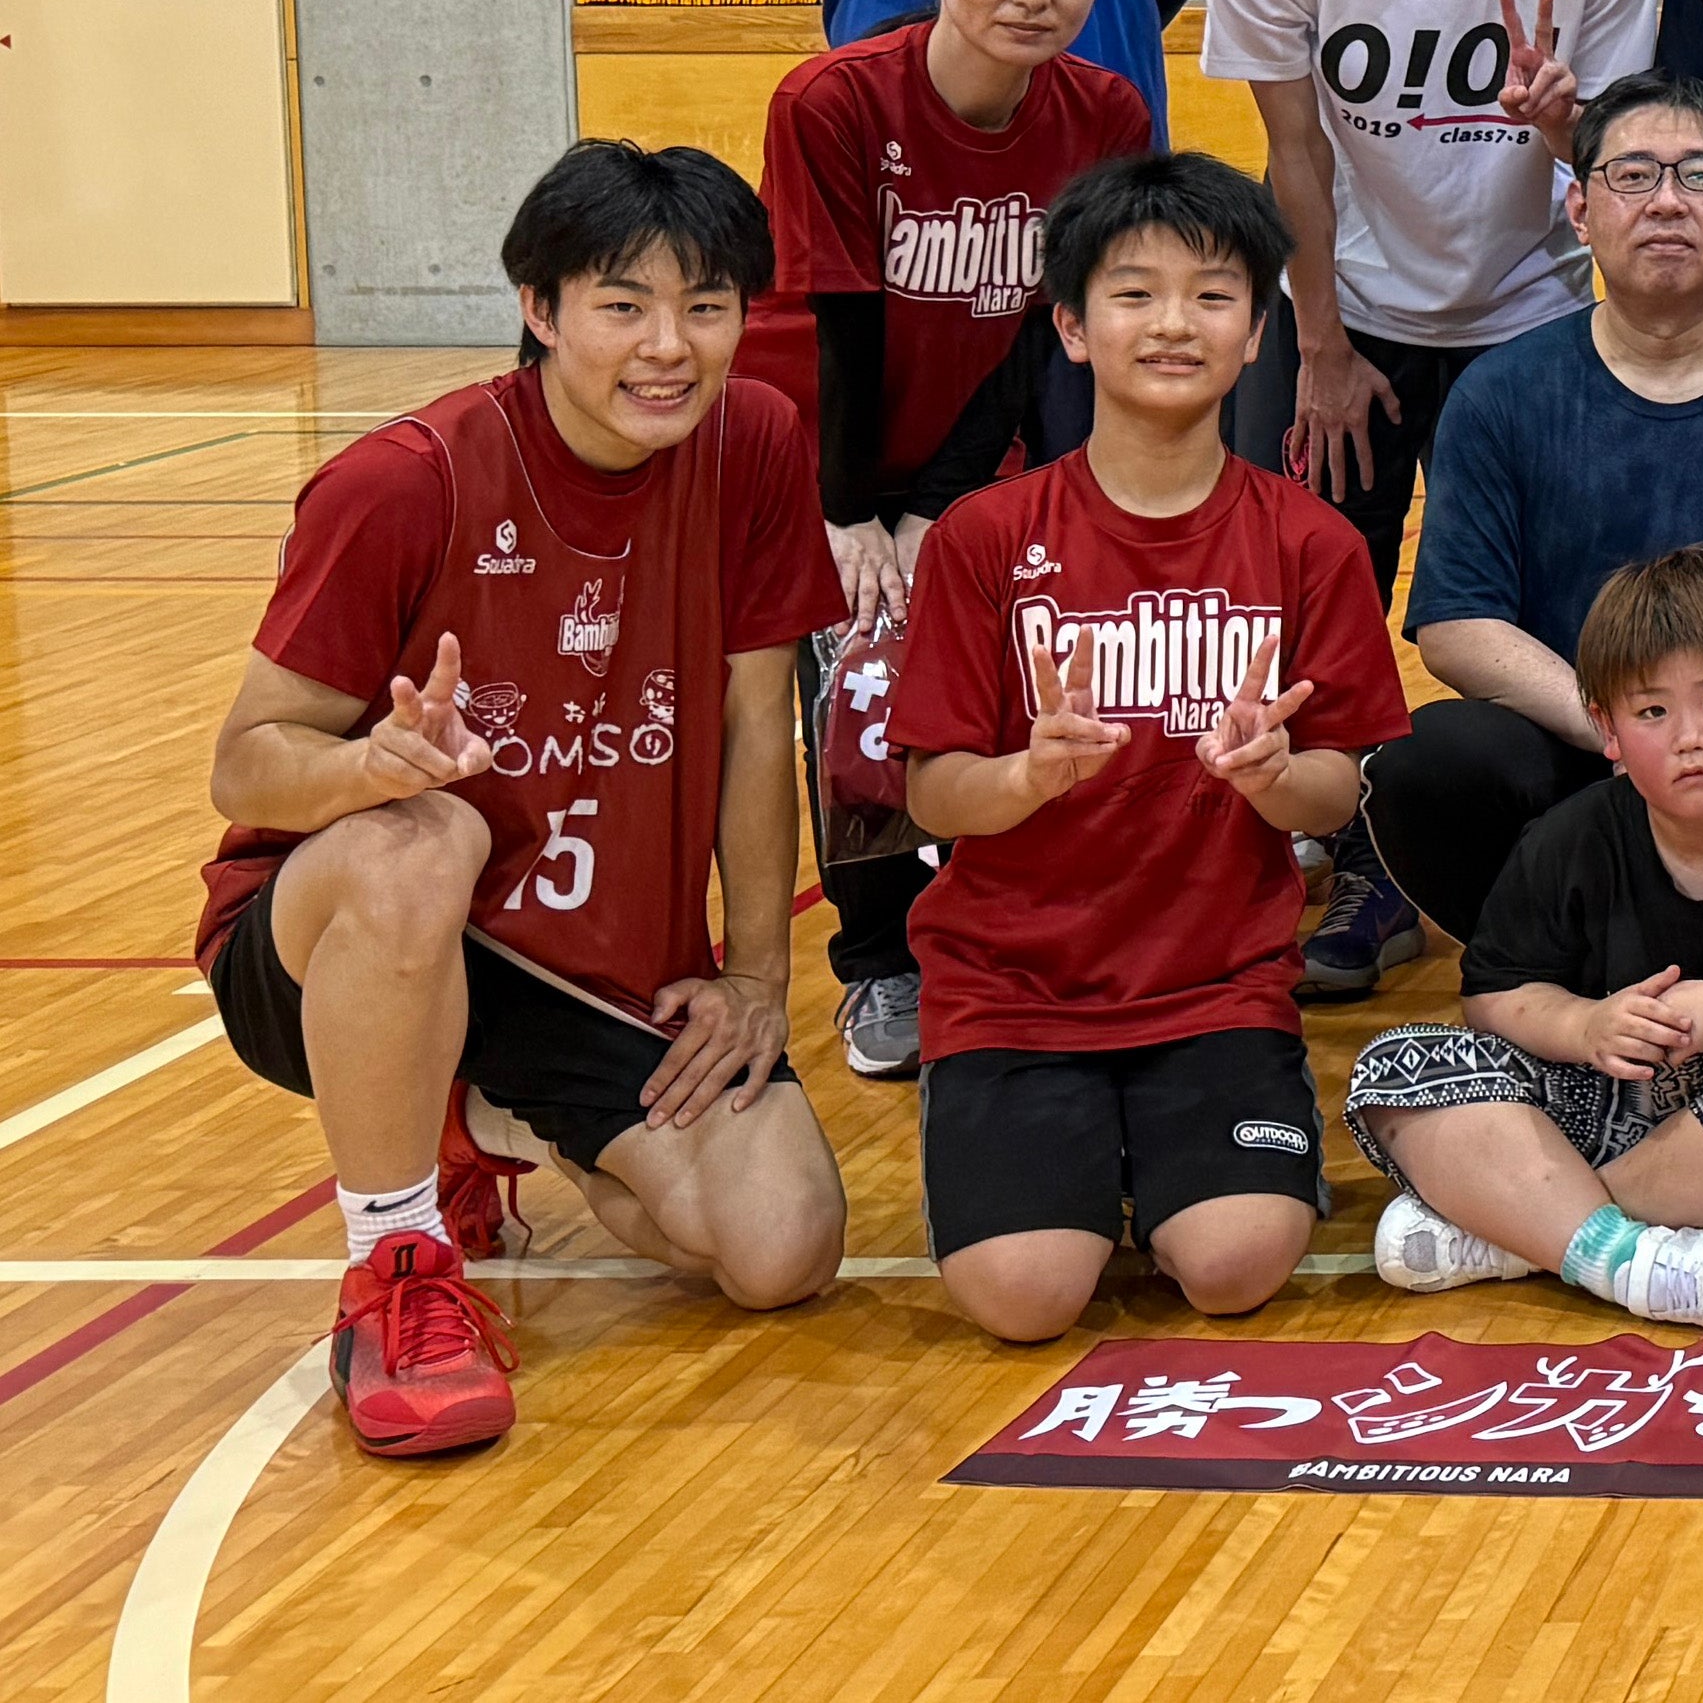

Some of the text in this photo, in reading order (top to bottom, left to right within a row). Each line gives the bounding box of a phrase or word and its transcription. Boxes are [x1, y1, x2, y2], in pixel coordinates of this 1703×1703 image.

[1340, 108, 1402, 138] 2019
[977, 285, 1024, 313] Nara
[1239, 1125, 1304, 1151] OUTDOOR
[1288, 1460, 1571, 1484] BAMBITIOUS NARA
